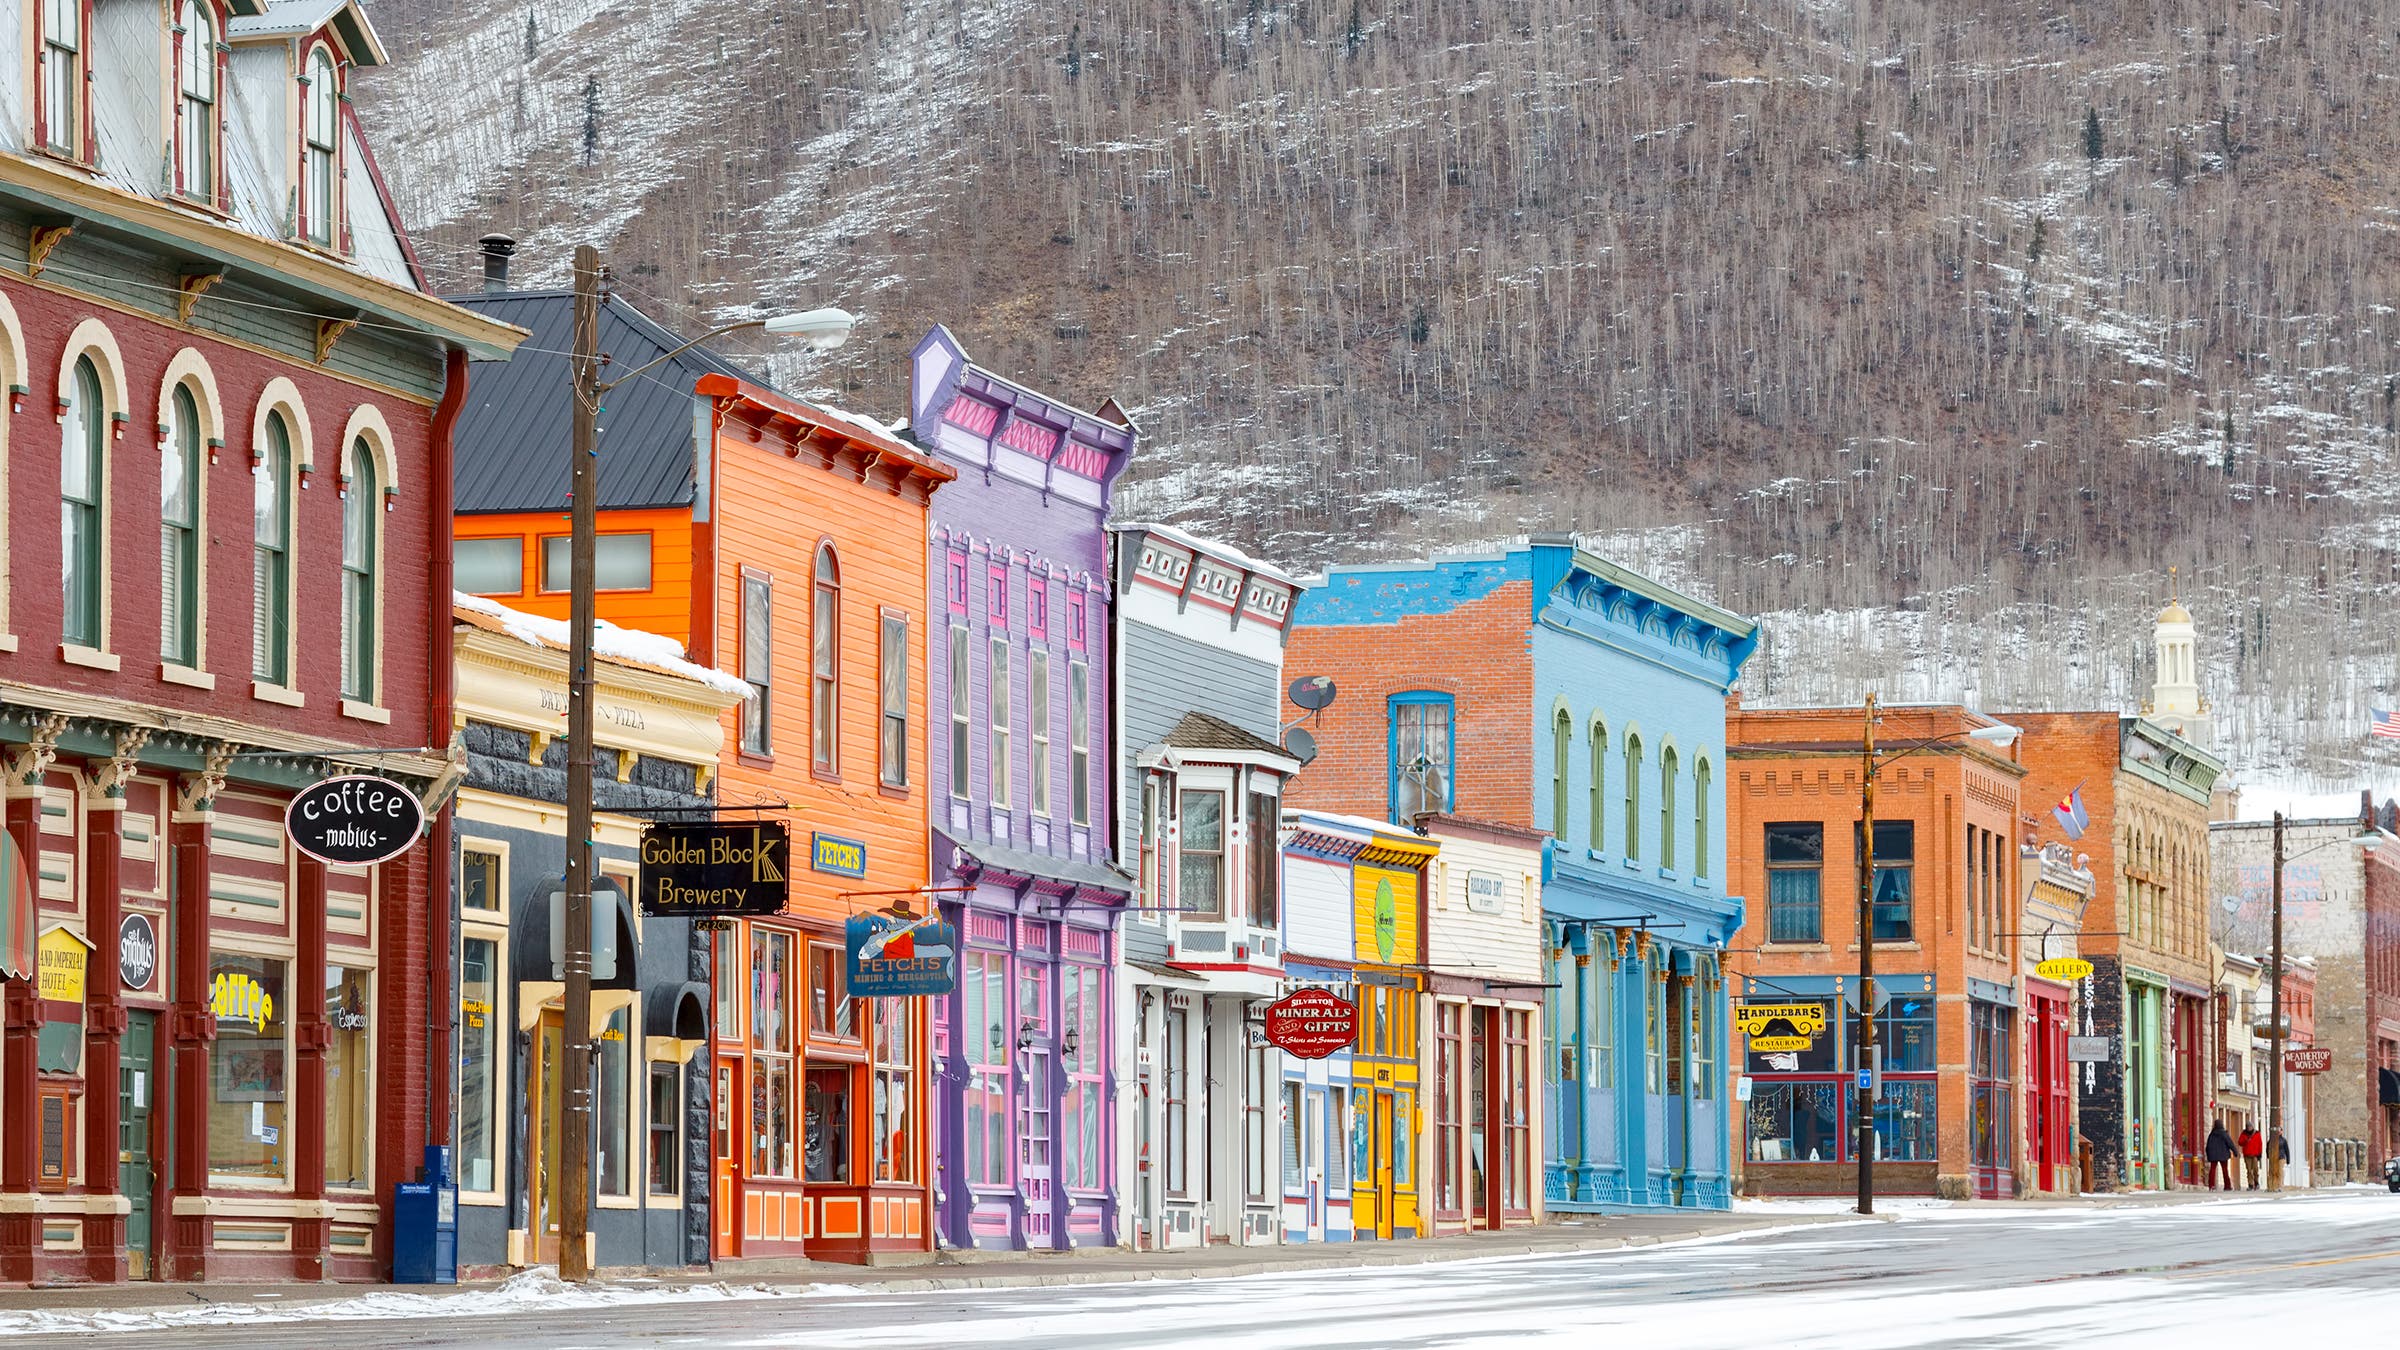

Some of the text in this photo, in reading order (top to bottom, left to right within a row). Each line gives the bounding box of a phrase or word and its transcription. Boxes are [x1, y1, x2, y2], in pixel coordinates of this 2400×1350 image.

[614, 706, 645, 730] PIZZA
[303, 782, 403, 820] coffee
[642, 837, 705, 865] Golden
[658, 877, 747, 909] Brewery
[38, 950, 83, 970] AND IMPERIAL
[2038, 964, 2090, 974] GALLERY
[41, 972, 66, 991] HOTEL
[854, 973, 884, 983] MINING
[1291, 998, 1334, 1007] SILVERTON
[1275, 1008, 1351, 1018] MINERALS
[1738, 1007, 1821, 1020] HANDLEBARS
[1278, 1021, 1350, 1032] AND GIFTS
[1755, 1039, 1804, 1048] RESTAURANT
[2285, 1051, 2330, 1062] WEATHERTOP
[2294, 1060, 2323, 1070] WOVENS
